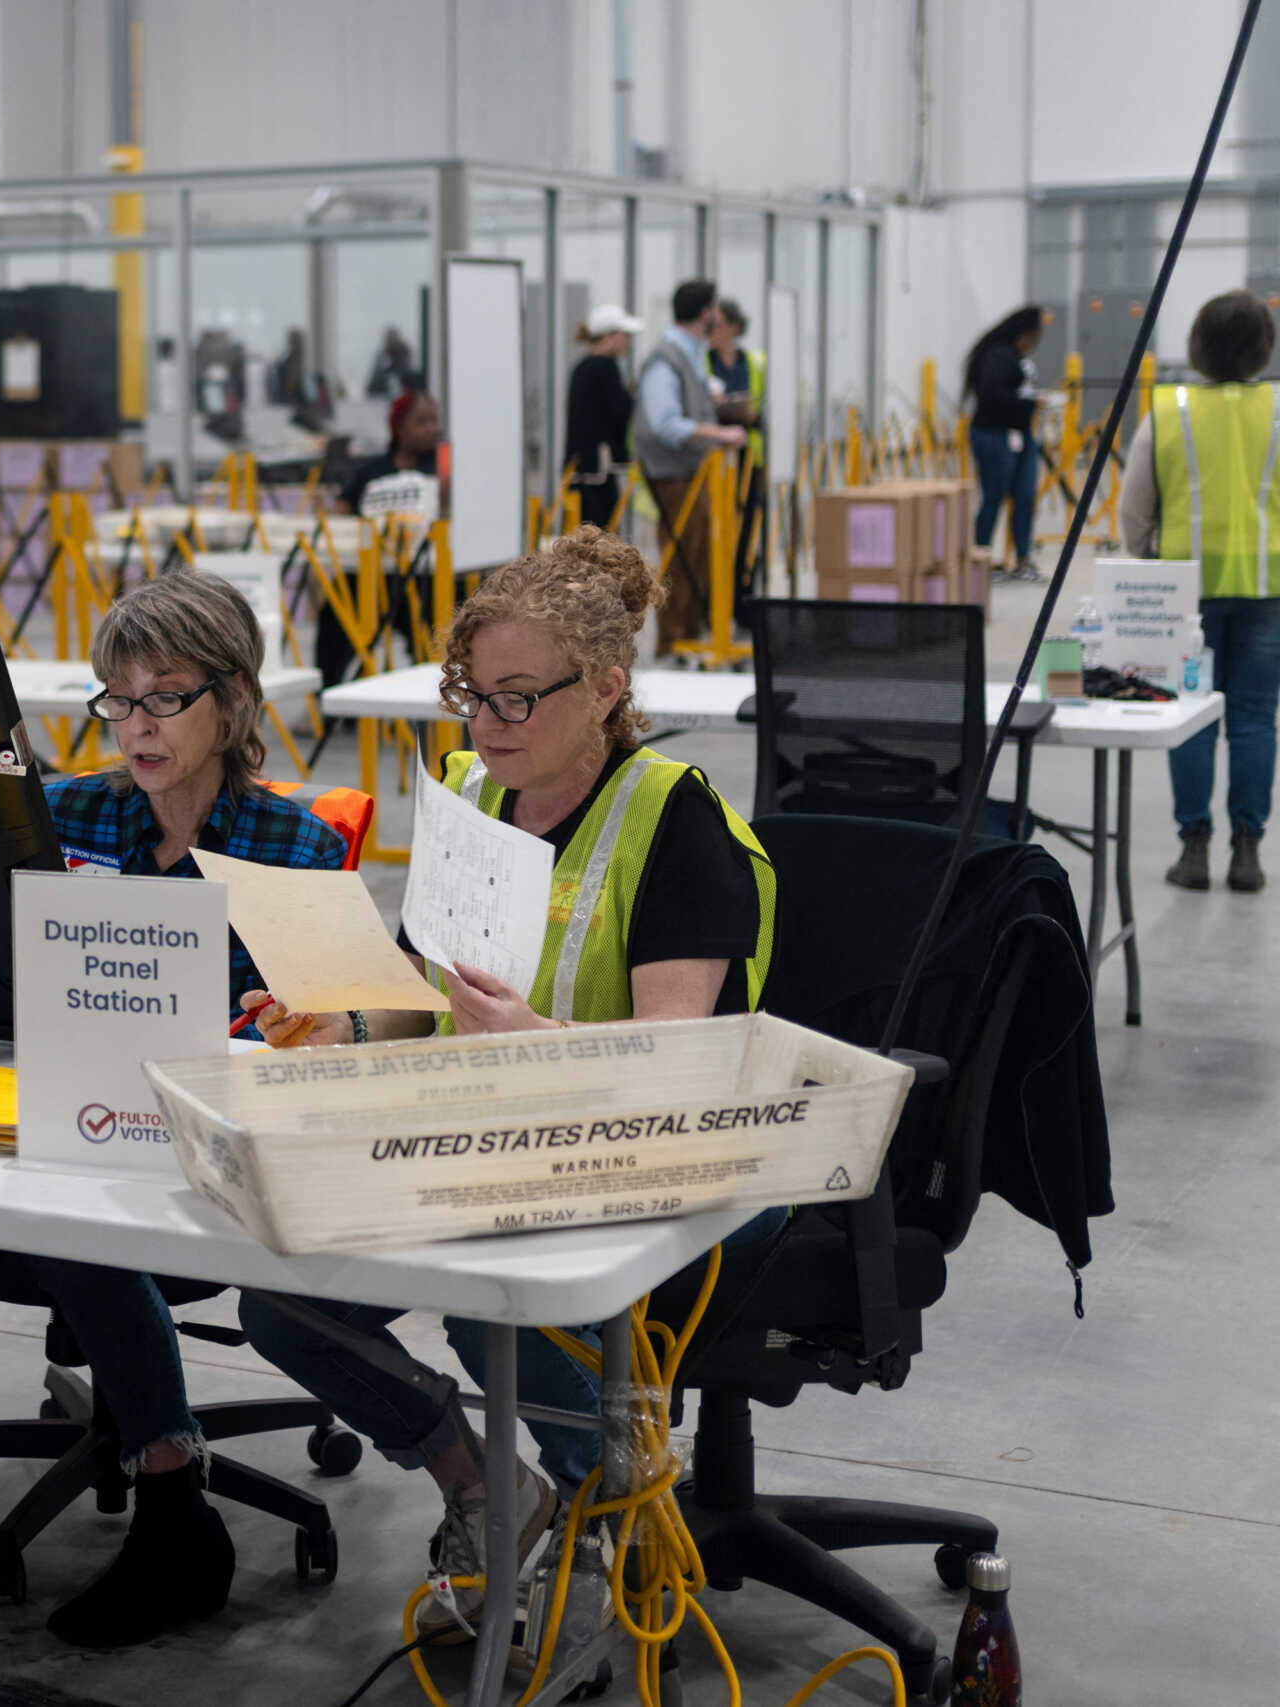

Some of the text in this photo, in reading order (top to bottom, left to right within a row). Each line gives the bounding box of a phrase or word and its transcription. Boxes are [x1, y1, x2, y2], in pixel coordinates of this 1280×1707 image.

[1115, 626, 1162, 638] Station
[90, 854, 121, 866] OFFICIAL
[44, 919, 199, 949] Duplication
[84, 956, 159, 981] Panel
[67, 987, 178, 1016] Station 1
[119, 1111, 166, 1128] FULTO
[120, 1127, 171, 1144] VOTES
[371, 1133, 472, 1162] UNITED
[477, 1123, 583, 1154] STATES
[588, 1112, 690, 1144] POSTAL
[696, 1099, 810, 1133] SERVICE
[551, 1155, 638, 1175] WARNING
[494, 1214, 525, 1231] MM
[530, 1208, 577, 1226] TRAY
